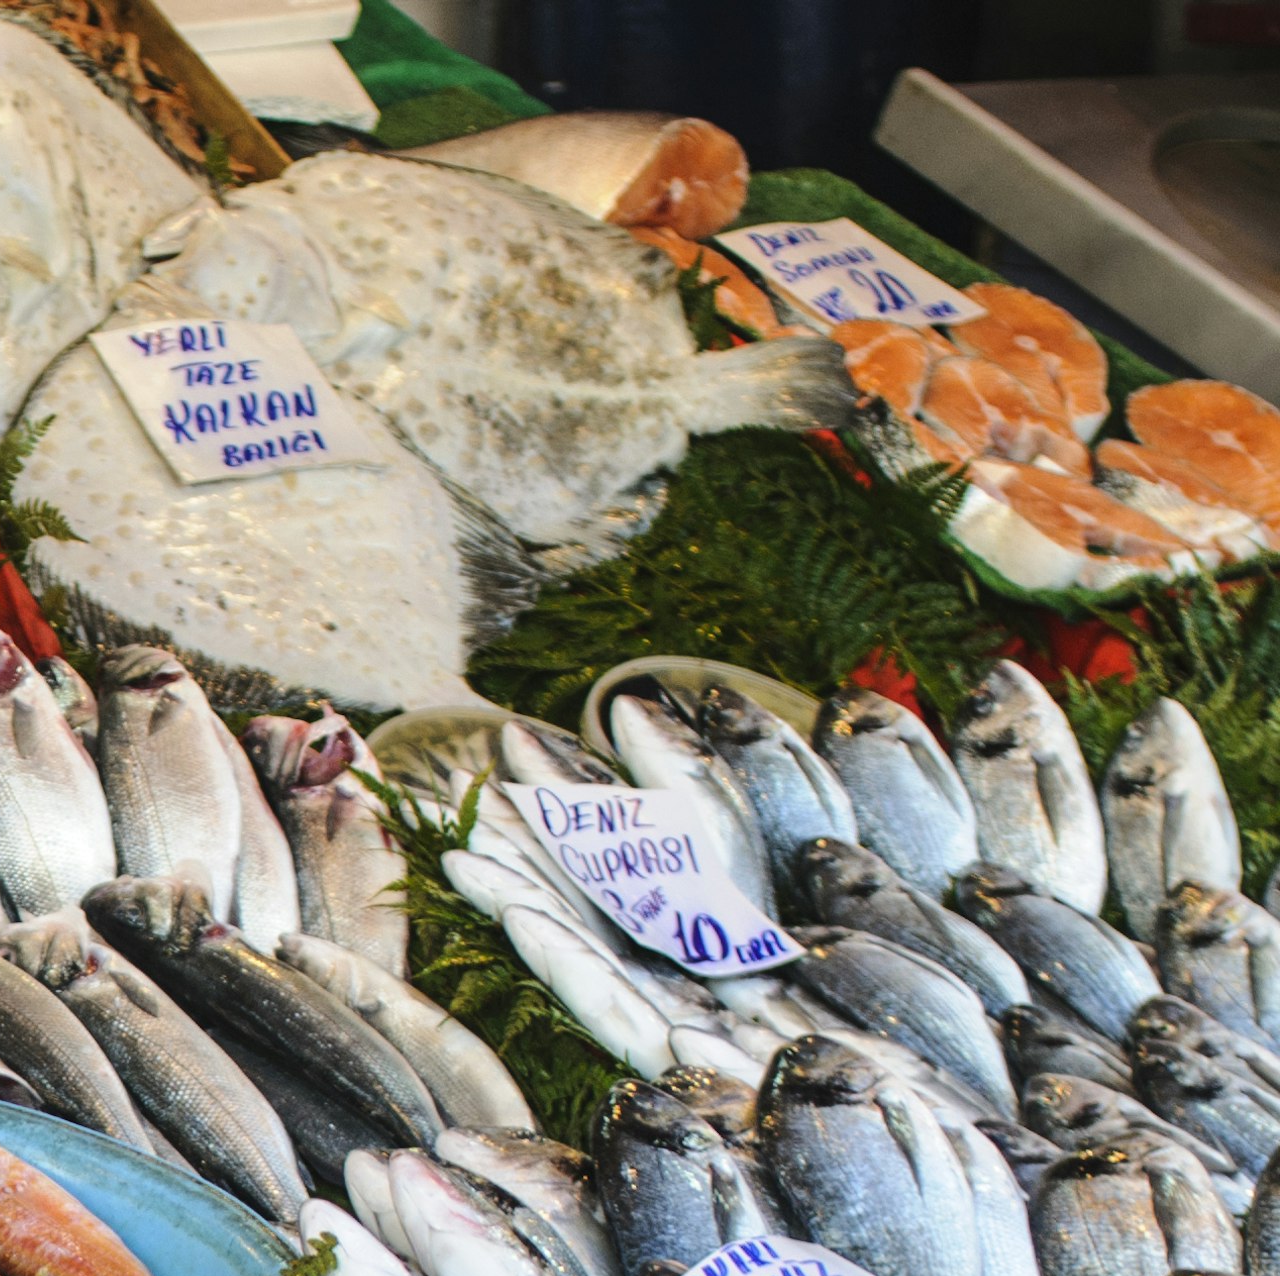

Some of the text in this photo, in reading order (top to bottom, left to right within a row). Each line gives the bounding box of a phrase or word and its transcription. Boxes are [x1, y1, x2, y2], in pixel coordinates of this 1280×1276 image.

[170, 359, 262, 387] TAZE
[163, 384, 319, 444] KALKAN
[672, 911, 729, 965] 10
